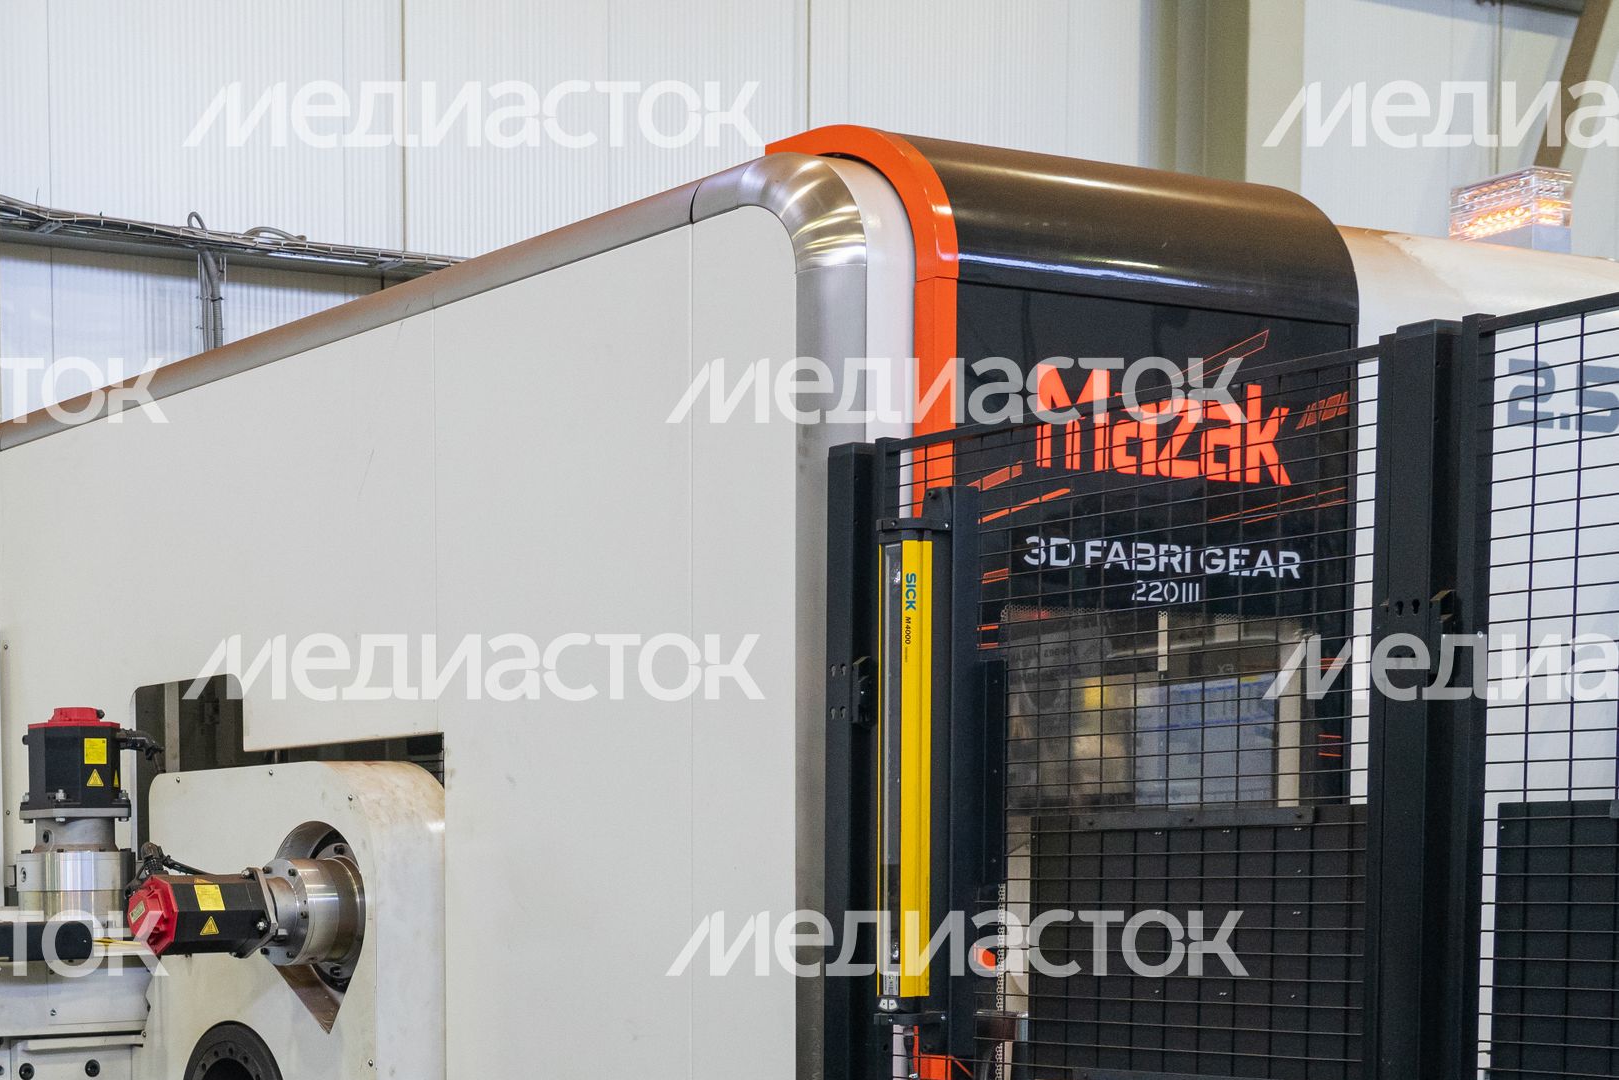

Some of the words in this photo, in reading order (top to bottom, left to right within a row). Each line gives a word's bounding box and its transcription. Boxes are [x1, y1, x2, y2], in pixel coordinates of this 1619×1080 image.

[1036, 364, 1291, 486] Mazak
[1023, 536, 1075, 567] 3D
[1200, 546, 1302, 579] GEAR
[905, 573, 916, 611] SICK
